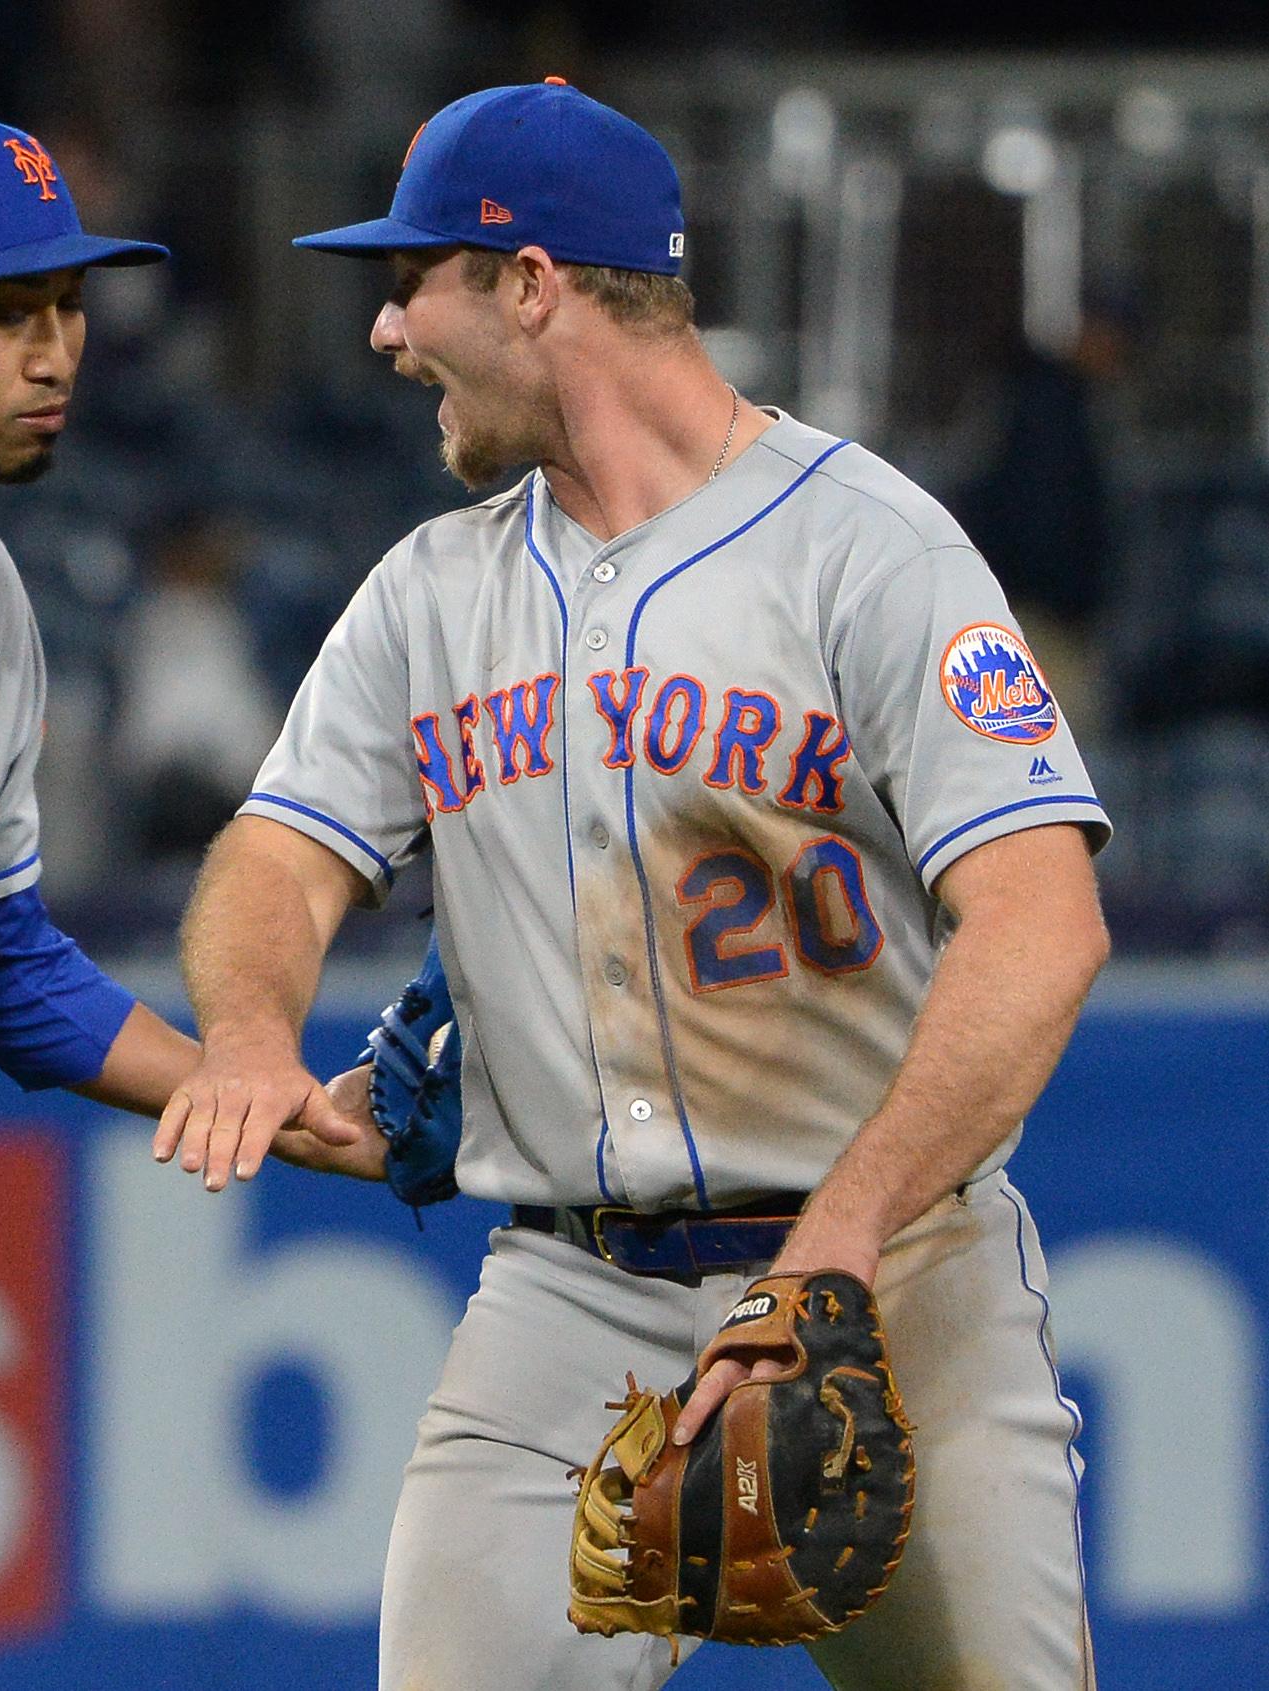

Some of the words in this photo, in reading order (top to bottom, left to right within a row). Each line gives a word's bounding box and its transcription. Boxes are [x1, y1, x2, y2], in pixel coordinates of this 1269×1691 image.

[411, 671, 561, 822] NEW
[586, 665, 853, 815] YORK
[971, 668, 1043, 718] Mets
[674, 833, 885, 996] 20
[736, 1456, 758, 1516] A2K
